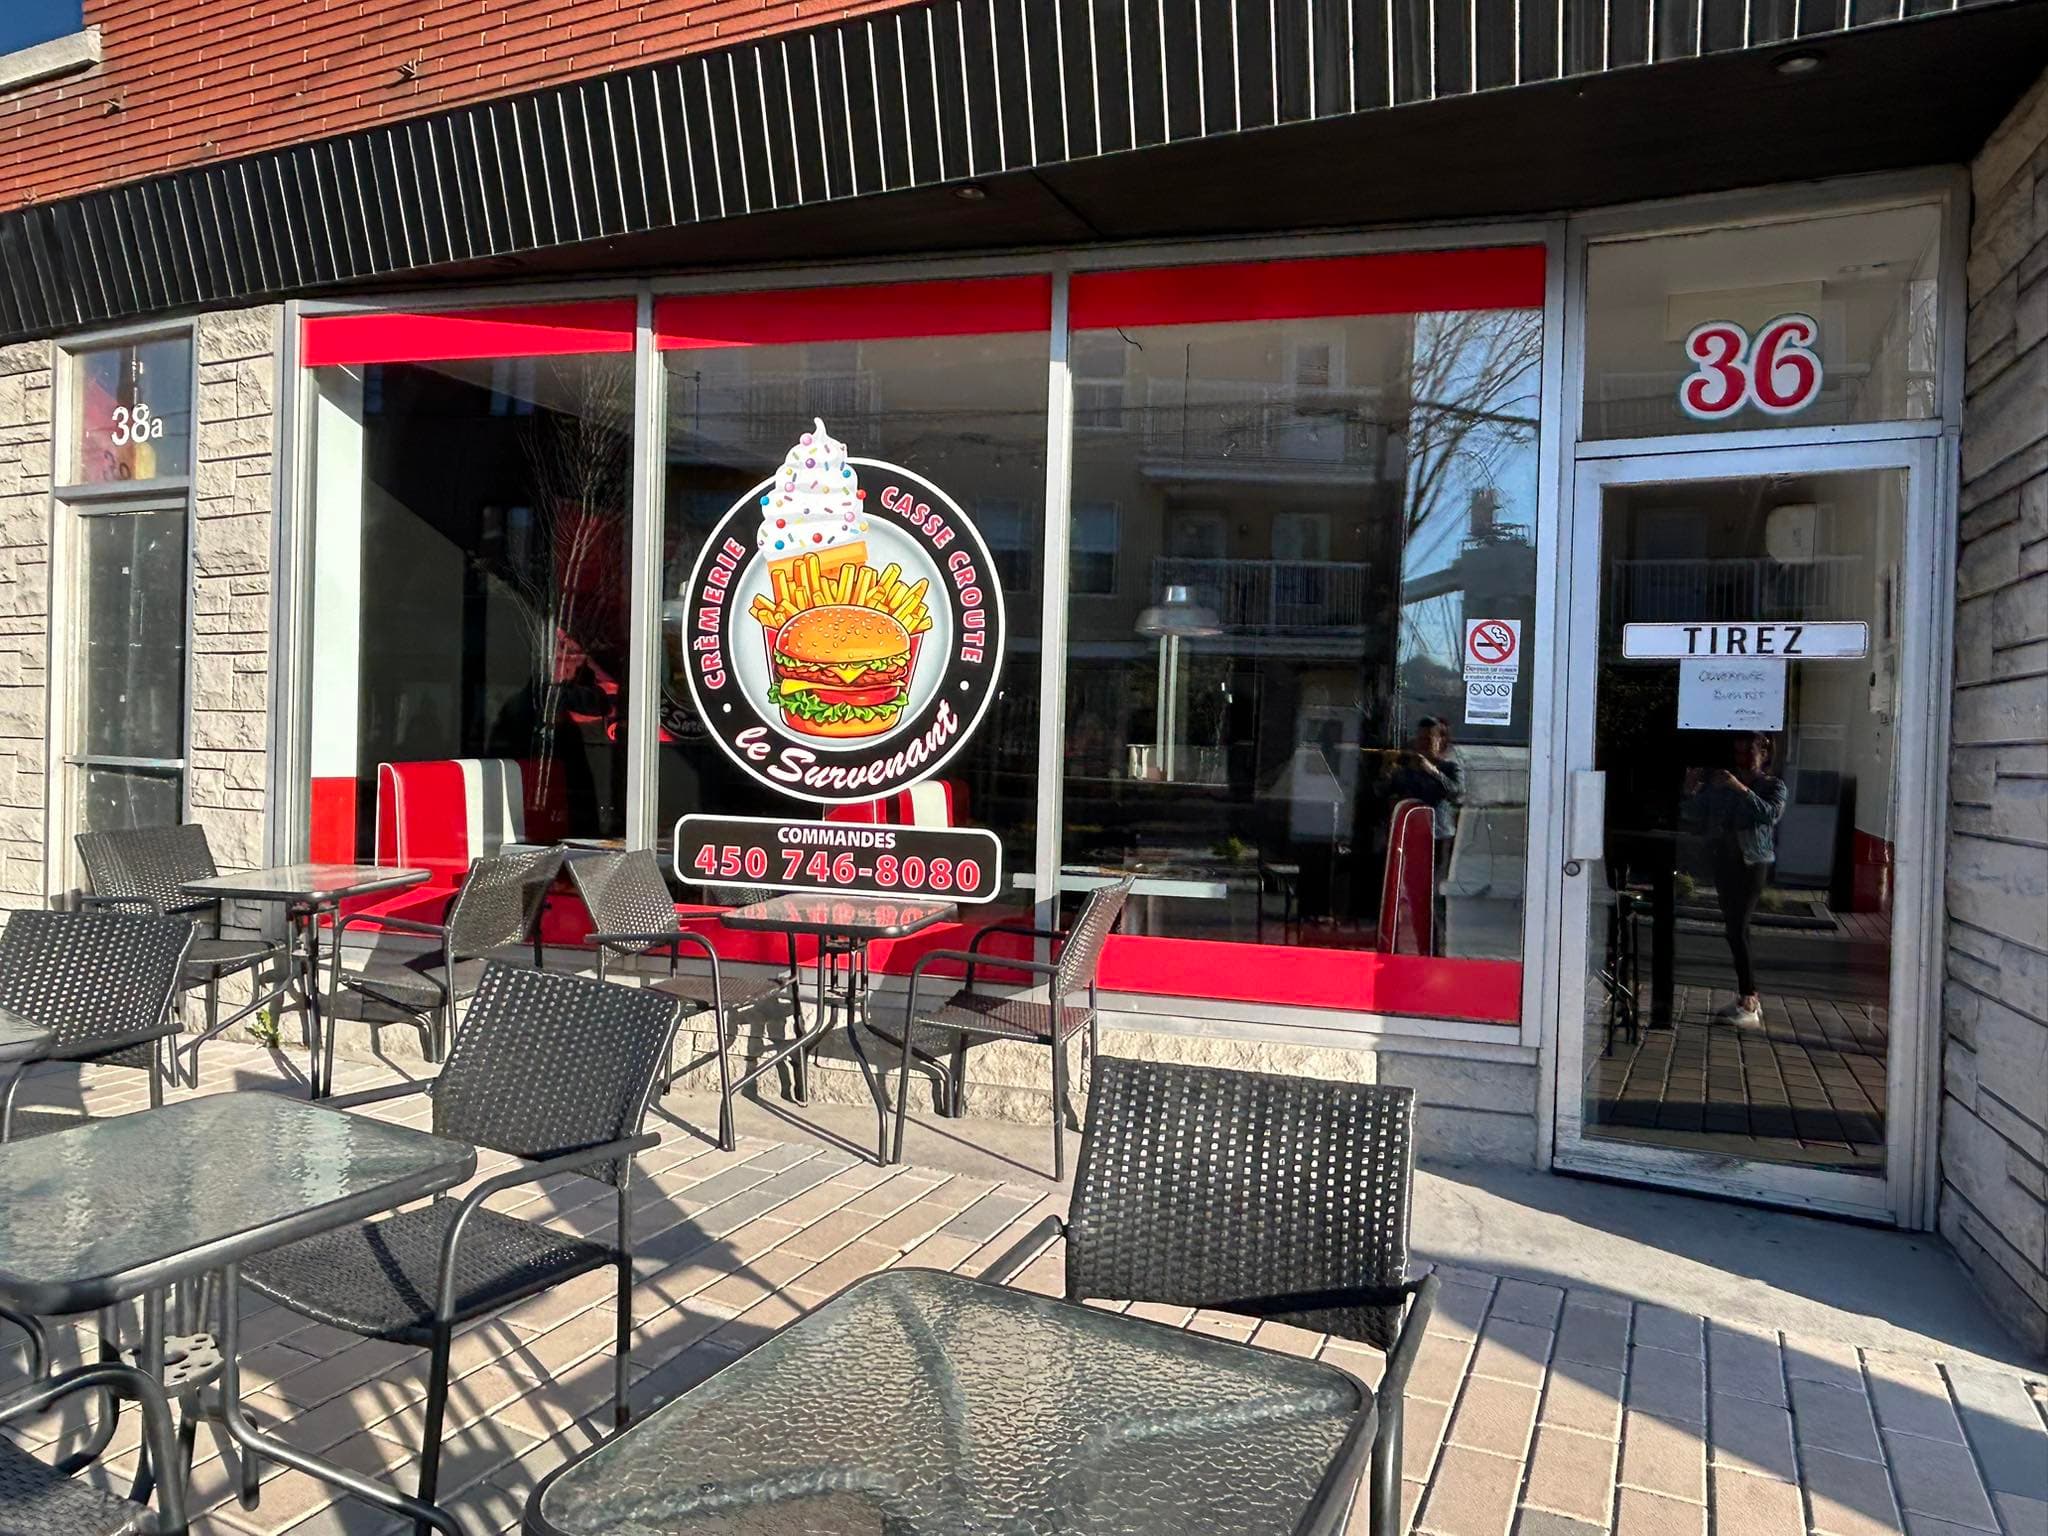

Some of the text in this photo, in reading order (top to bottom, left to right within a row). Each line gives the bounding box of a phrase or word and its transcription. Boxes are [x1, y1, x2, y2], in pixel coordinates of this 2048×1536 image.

[1681, 313, 1823, 419] 36
[111, 403, 163, 446] 38a
[880, 486, 985, 663] CASSE CROUTE
[694, 537, 746, 689] CRÈMERIE
[1683, 627, 1803, 654] TIREZ
[735, 727, 771, 760] le
[767, 699, 958, 789] Survenant
[694, 844, 981, 892] 450 746-8080
[777, 827, 896, 849] COMMANDES
